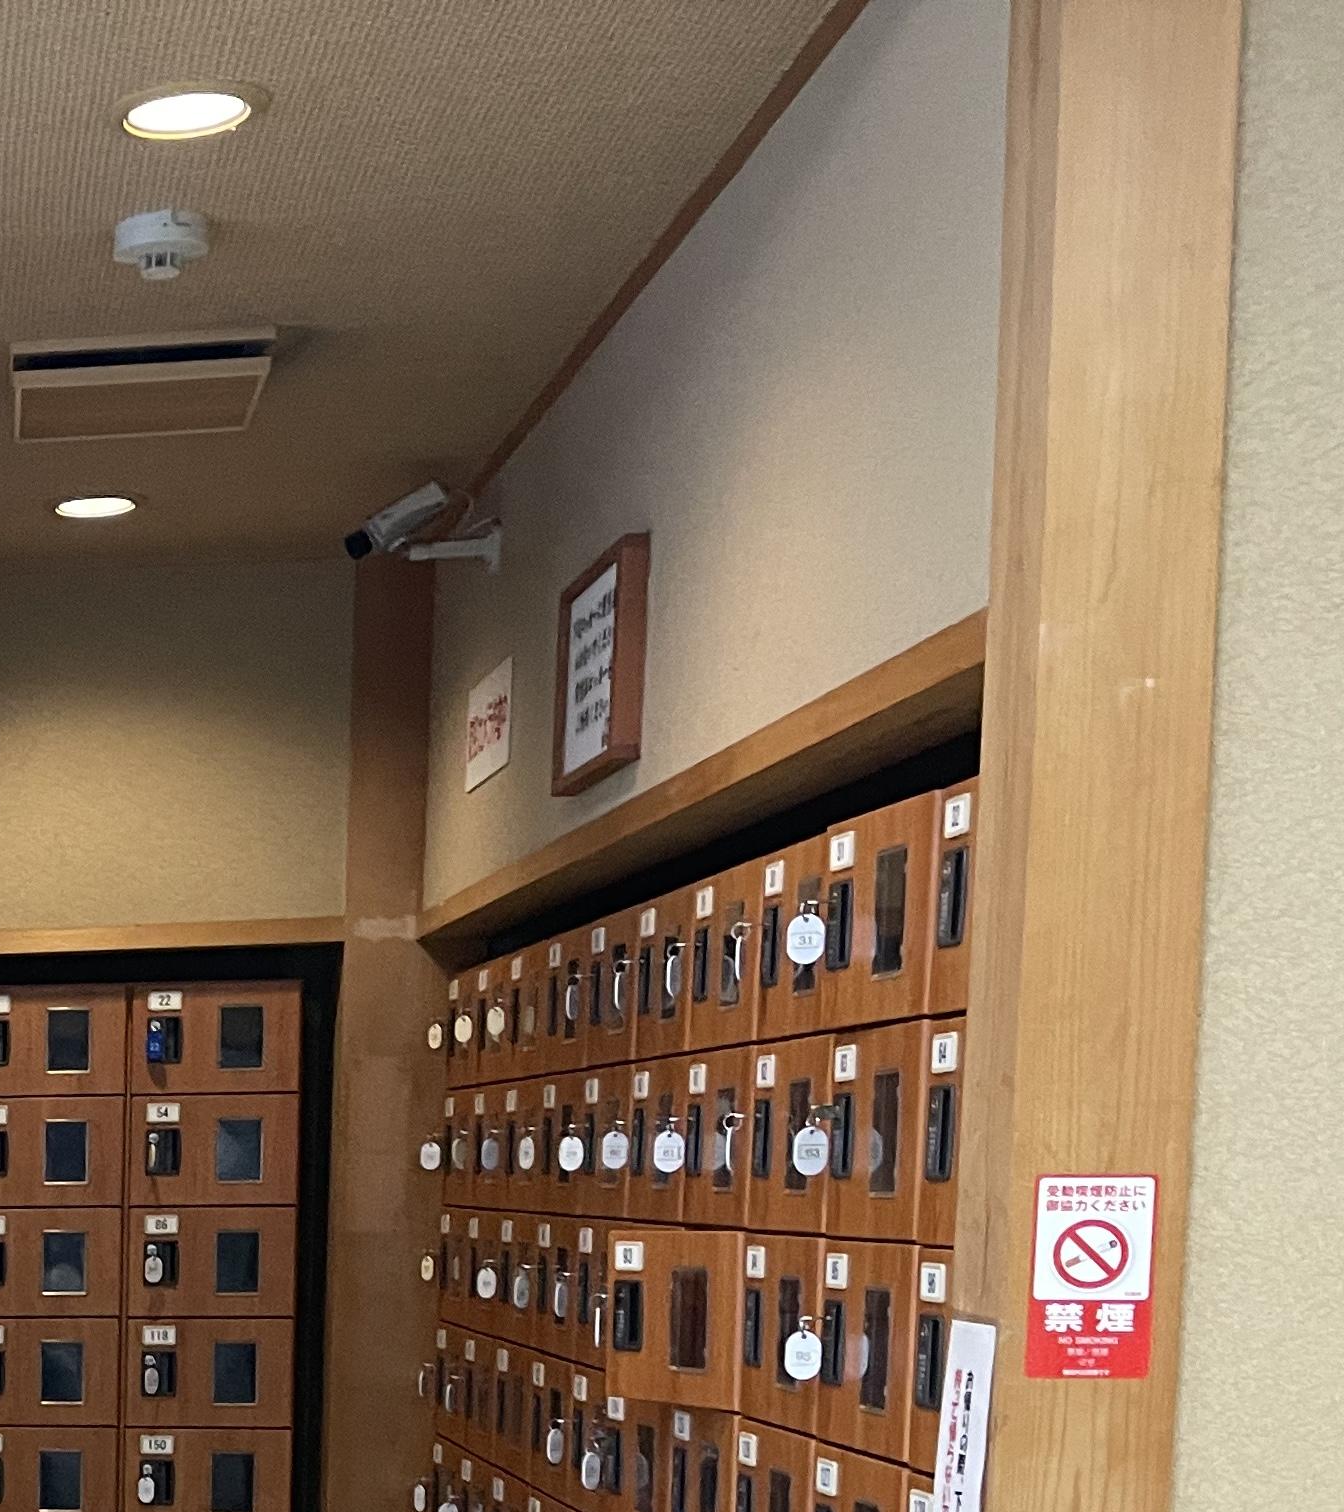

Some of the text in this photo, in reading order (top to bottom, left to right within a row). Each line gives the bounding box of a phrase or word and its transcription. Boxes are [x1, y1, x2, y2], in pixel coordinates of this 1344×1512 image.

[798, 934, 814, 946] 31
[1044, 1302, 1136, 1333] 禁煙
[1058, 1336, 1119, 1345] NO SMOKING
